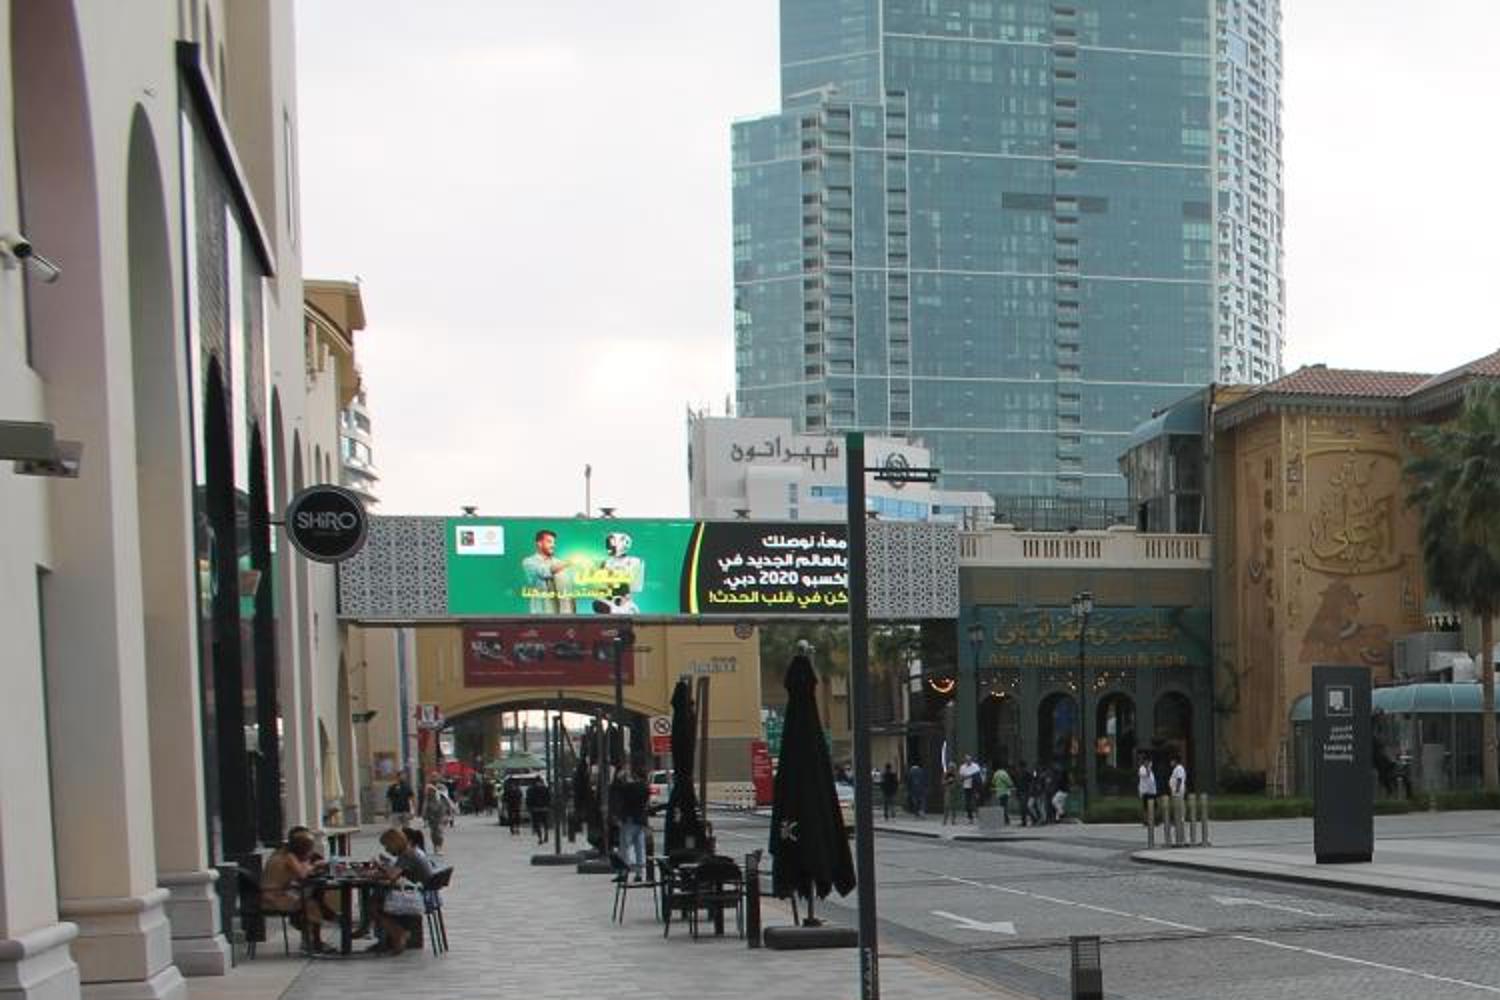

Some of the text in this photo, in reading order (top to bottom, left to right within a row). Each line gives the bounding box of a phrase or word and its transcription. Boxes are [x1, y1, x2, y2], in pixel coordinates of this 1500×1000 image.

[730, 435, 839, 470] شيراتون
[717, 553, 743, 572] في
[746, 553, 794, 568] الجديد
[759, 571, 799, 585] 2020
[761, 591, 795, 606] قلب
[797, 591, 822, 608] في
